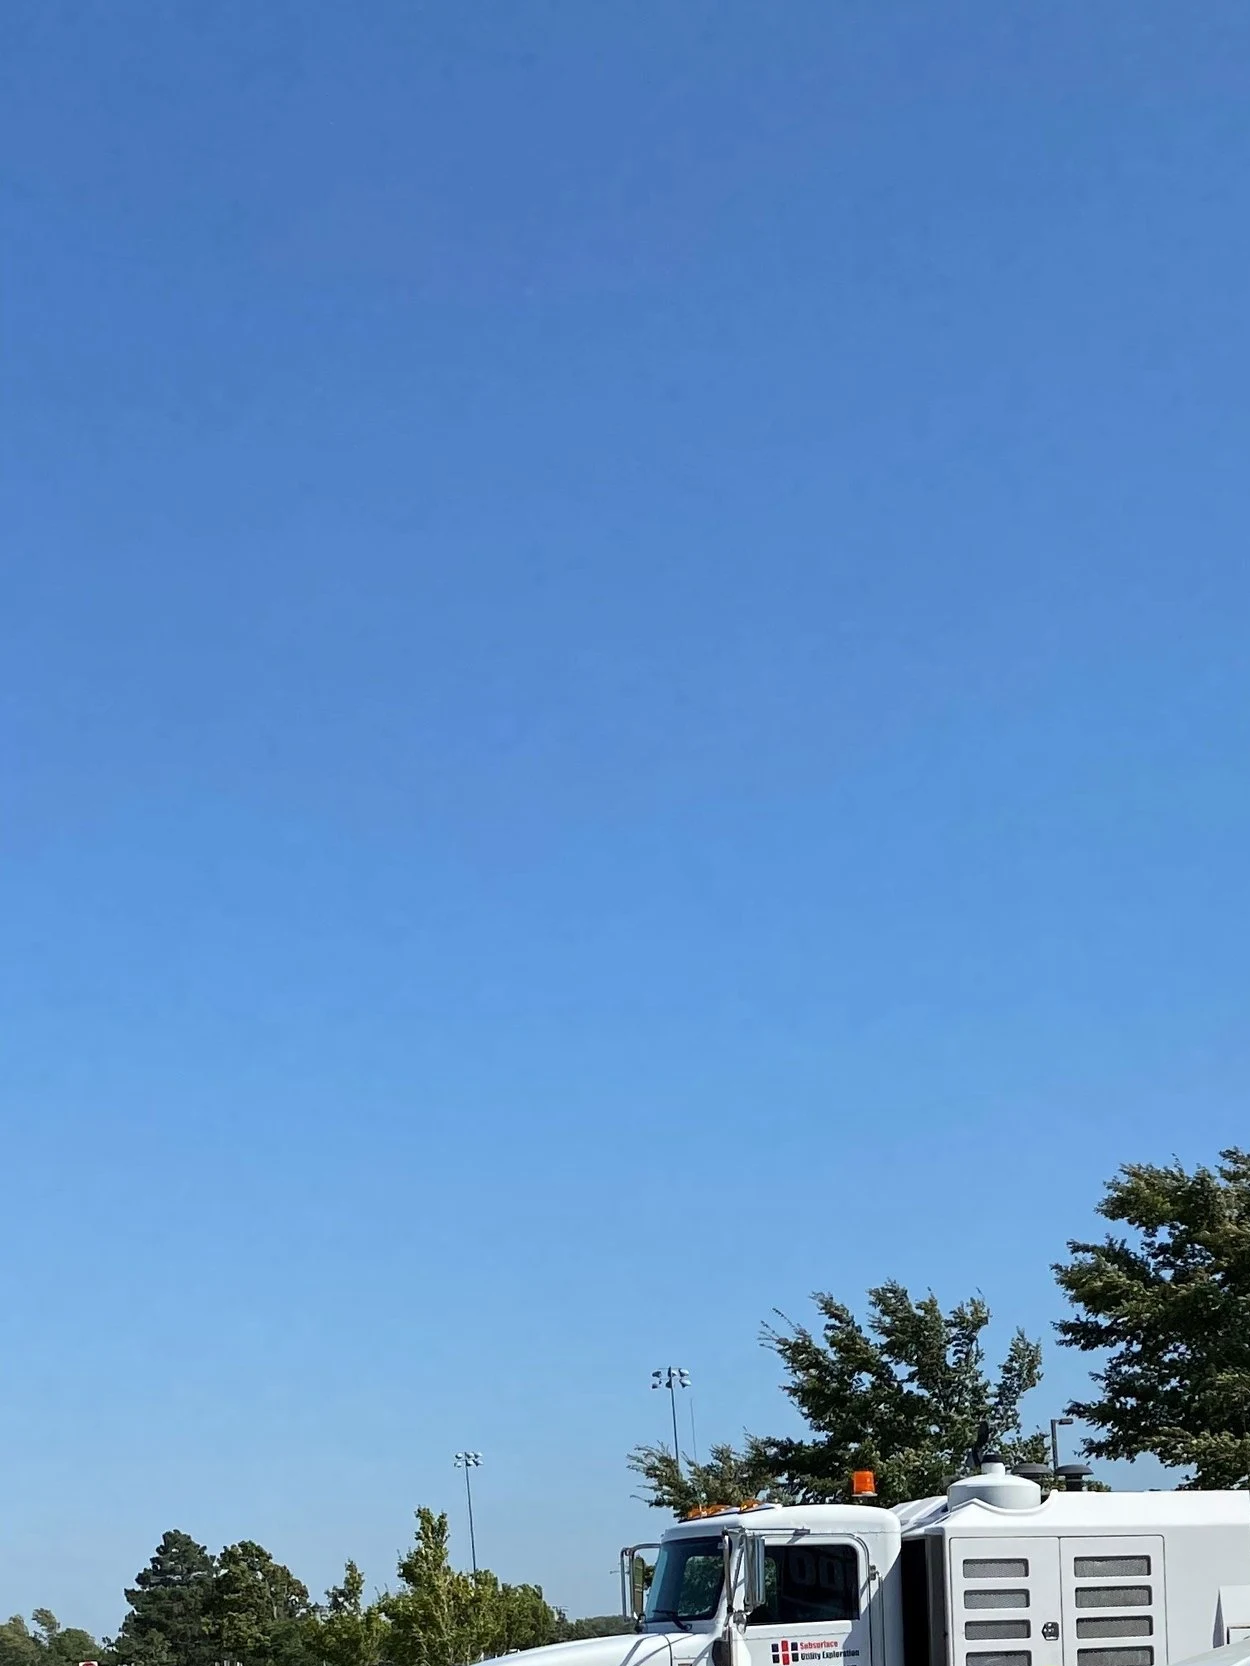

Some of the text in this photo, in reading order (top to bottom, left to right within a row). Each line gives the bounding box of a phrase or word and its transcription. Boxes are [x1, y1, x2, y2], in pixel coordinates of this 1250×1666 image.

[800, 1640, 838, 1650] Subsurface
[801, 1648, 860, 1661] Utility Exploration
